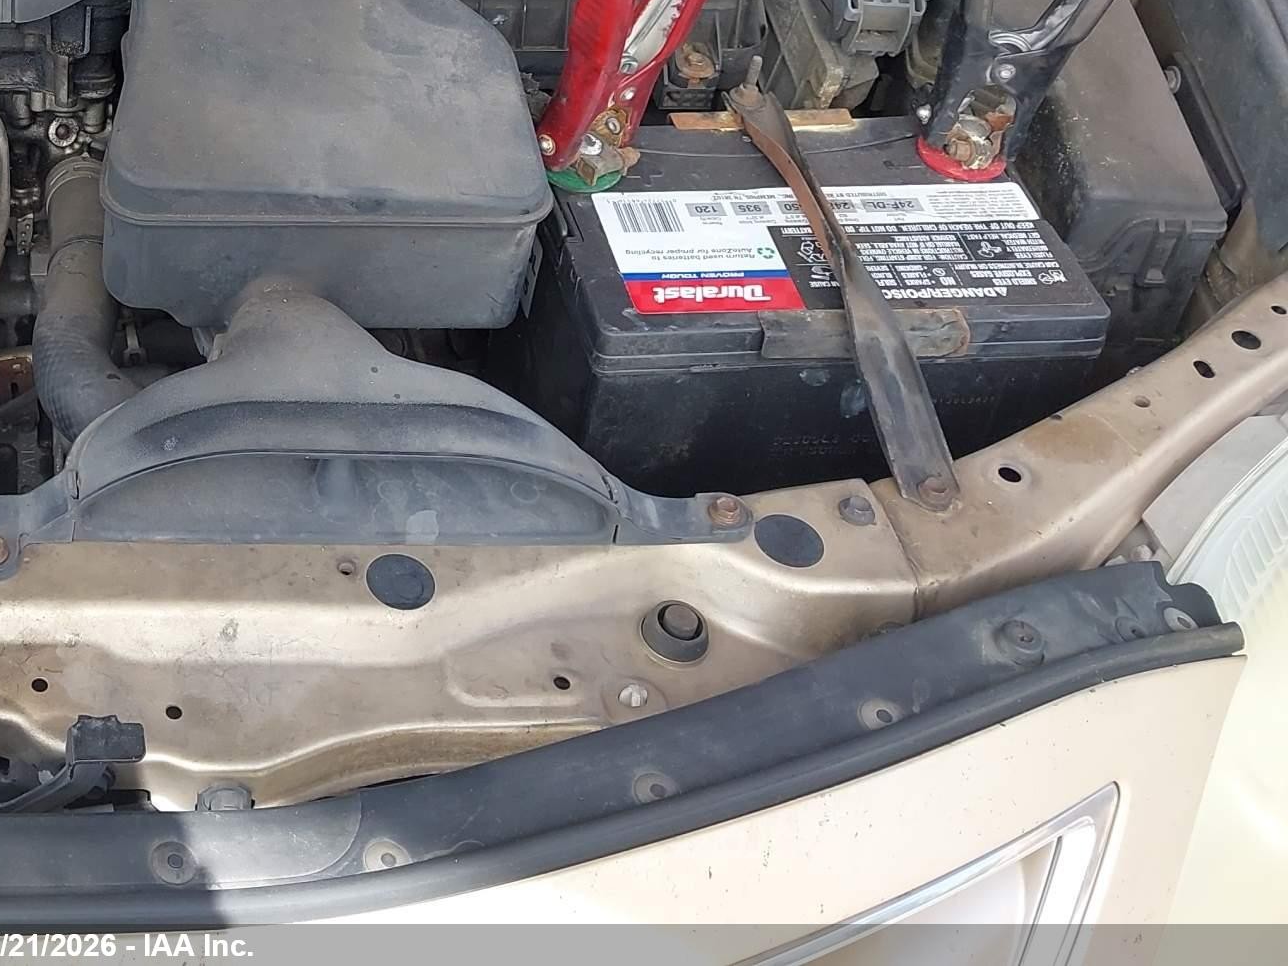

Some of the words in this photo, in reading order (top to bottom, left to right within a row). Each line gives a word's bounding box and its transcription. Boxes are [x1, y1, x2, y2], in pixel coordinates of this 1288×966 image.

[695, 205, 718, 213] 120
[738, 204, 762, 212] 935
[783, 203, 803, 212] 50
[867, 201, 914, 209] 24F-DL
[939, 277, 956, 285] NO
[652, 284, 772, 303] Duralast
[881, 287, 998, 299] DANGER/POISO
